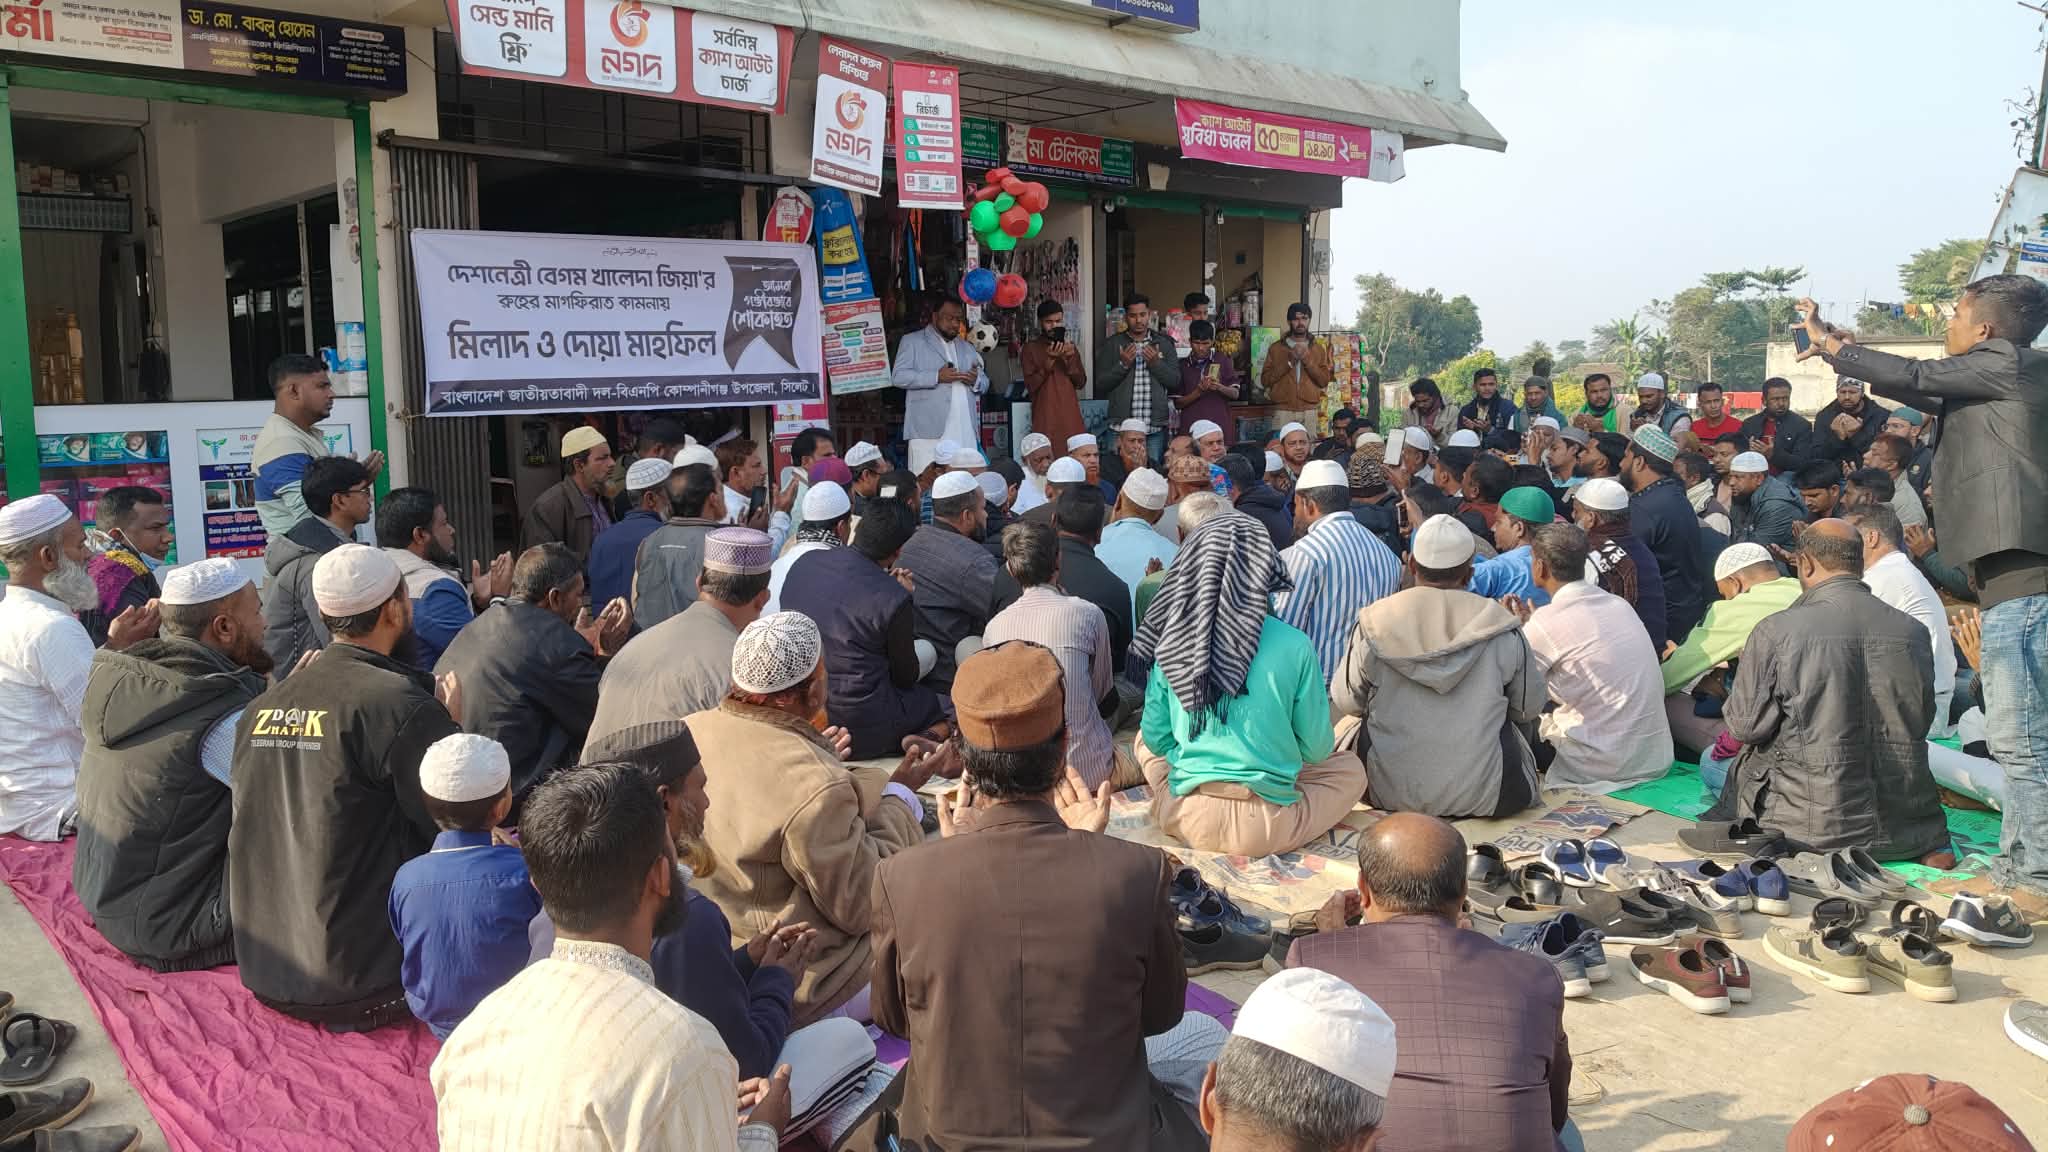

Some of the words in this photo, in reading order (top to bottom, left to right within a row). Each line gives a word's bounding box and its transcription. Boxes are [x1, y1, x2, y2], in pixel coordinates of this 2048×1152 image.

[241, 15, 275, 39] বাবলু
[278, 20, 315, 39] হোসেন
[470, 5, 509, 27] সেন্ড
[513, 7, 554, 32] মানি
[713, 27, 758, 52] সর্বনিম্ন
[601, 48, 662, 80] নগদ
[698, 48, 732, 68] ক্যাশ
[735, 53, 773, 75] আউট
[720, 74, 751, 93] চার্জ
[825, 127, 872, 161] নগদ
[1181, 122, 1217, 147] সুবিধা
[1219, 132, 1251, 152] ডাবল
[1257, 127, 1280, 151] ৫০
[1028, 138, 1044, 160] মা
[1048, 137, 1100, 168] টেলিকম
[447, 259, 532, 287] দেশনেত্রী
[537, 266, 586, 287] বেগম
[592, 268, 653, 288] খালেদা
[498, 295, 539, 310] রুহের
[543, 292, 614, 311] মাগফিরাত
[618, 295, 671, 311] কামনায়
[733, 309, 794, 332] শোকাহত
[447, 319, 529, 360] মিলাদ
[537, 330, 556, 359] ও
[564, 330, 620, 362] দোয়া
[627, 320, 716, 360] মাহফিল
[440, 389, 503, 406] বাংলাদেশ
[509, 385, 588, 404] জাতীয়তাবাদী
[664, 380, 729, 399] কোম্পানীগঞ্জ
